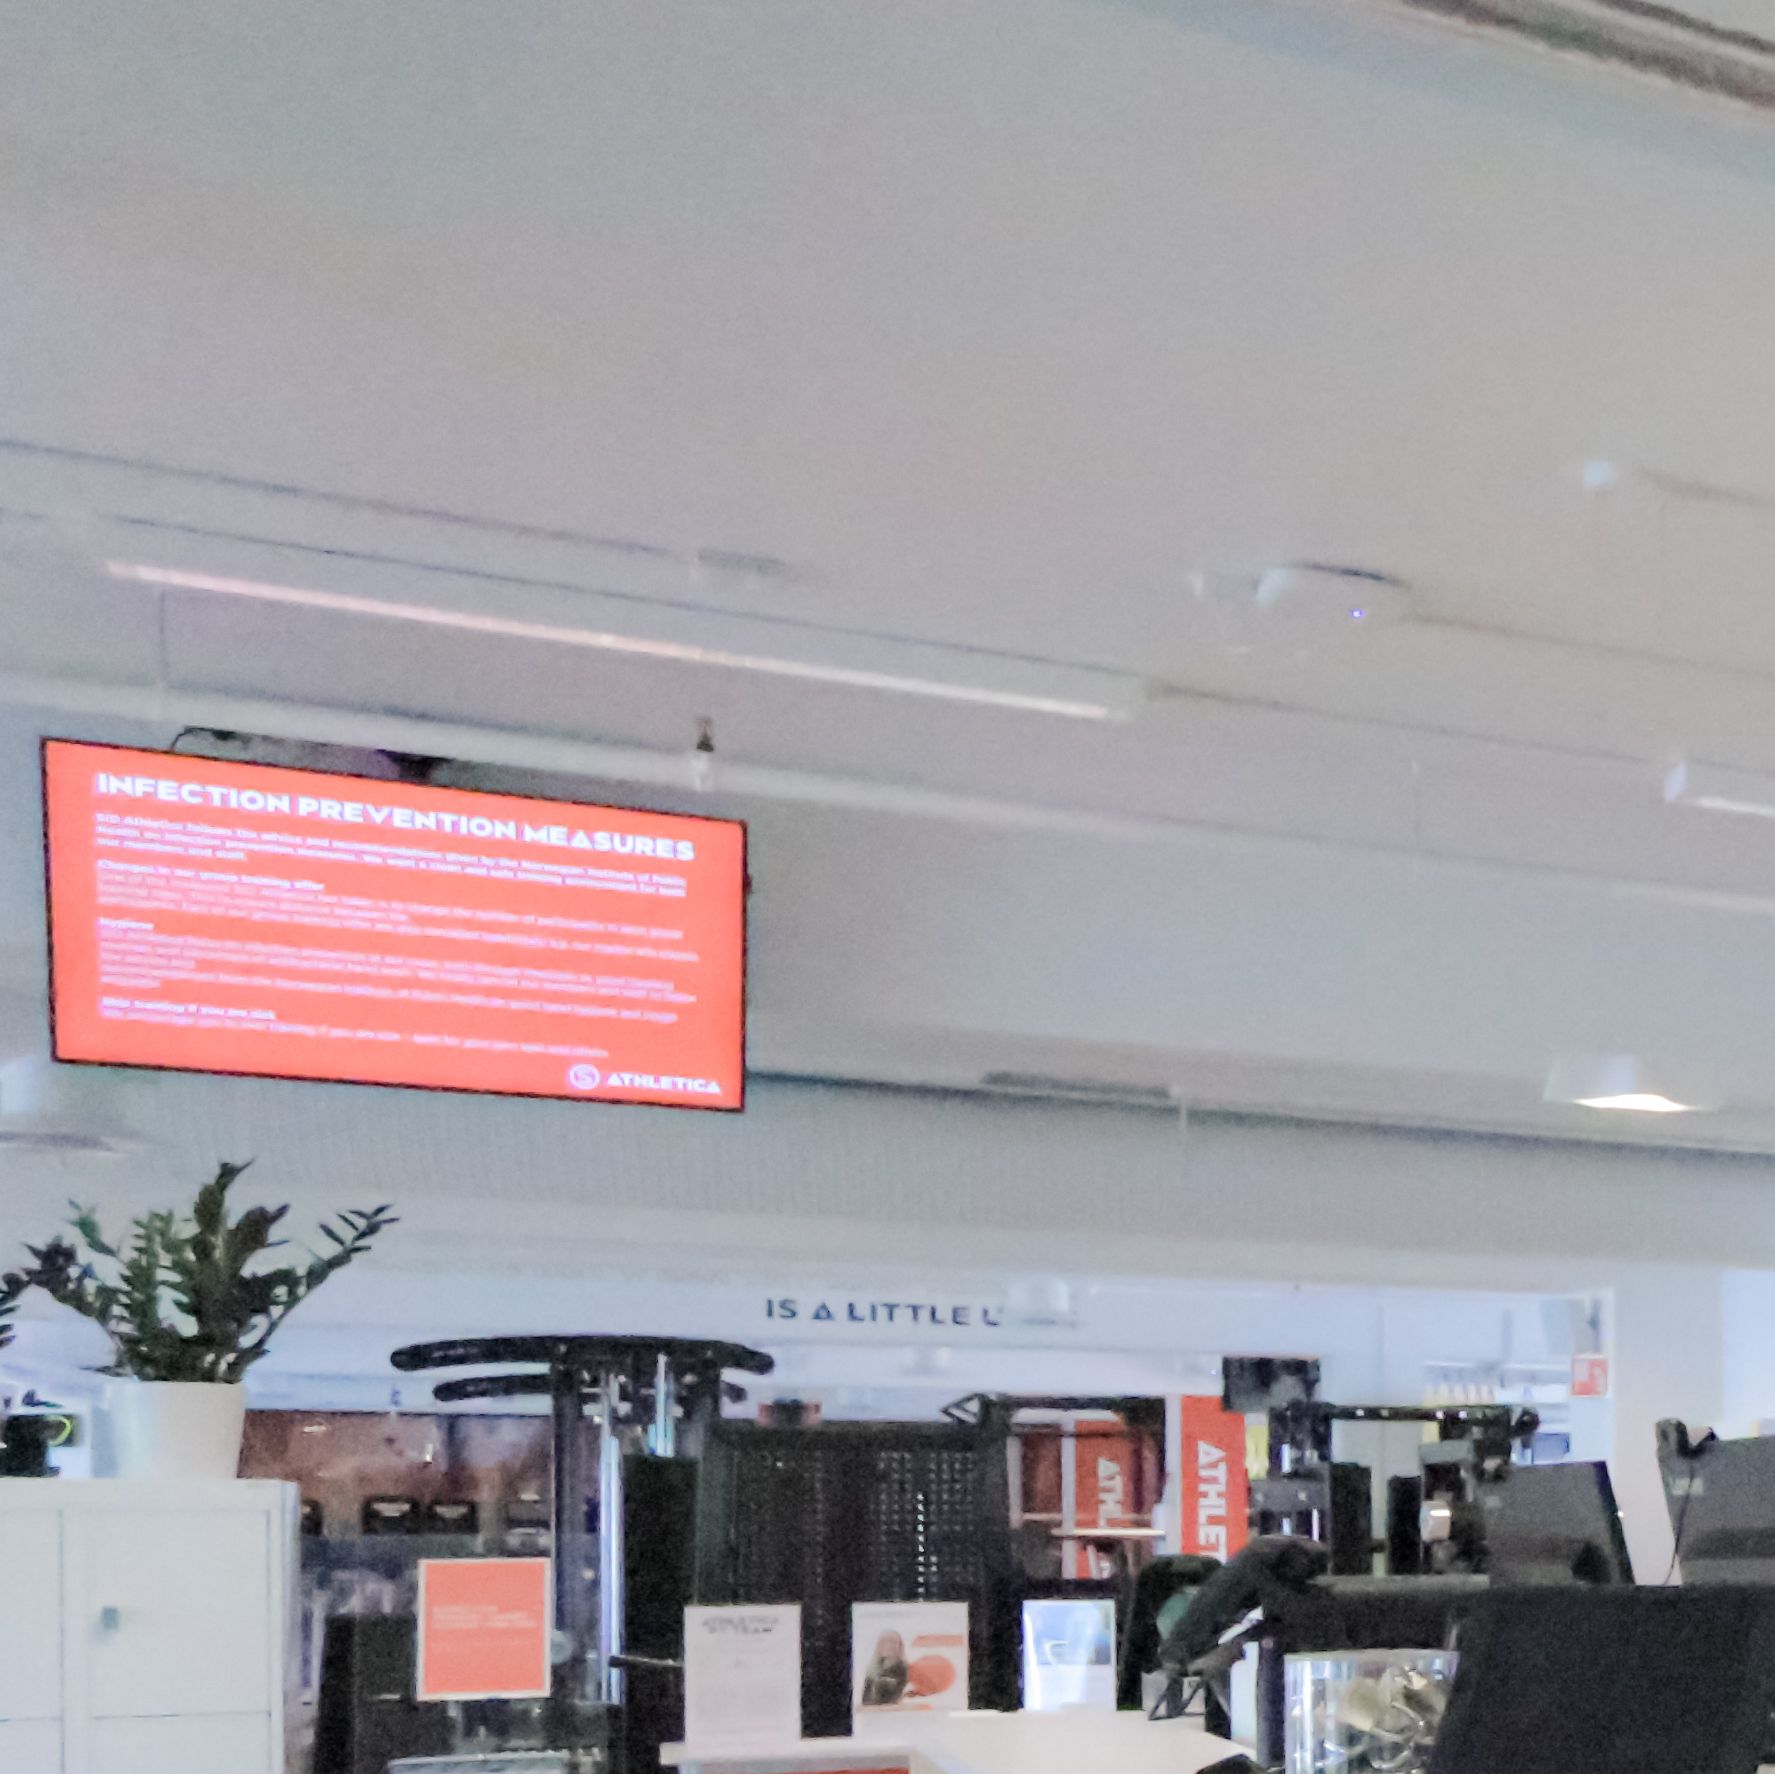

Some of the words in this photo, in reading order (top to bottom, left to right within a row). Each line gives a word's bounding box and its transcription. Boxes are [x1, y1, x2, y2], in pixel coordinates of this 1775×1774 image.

[98, 774, 289, 813] INFECTION
[298, 797, 516, 839] PREVENTION
[524, 824, 694, 861] MEASURES
[607, 1073, 721, 1094] ATHLETICA
[766, 1299, 797, 1319] IS
[812, 1303, 834, 1321] A
[847, 1303, 970, 1325] LITTLE
